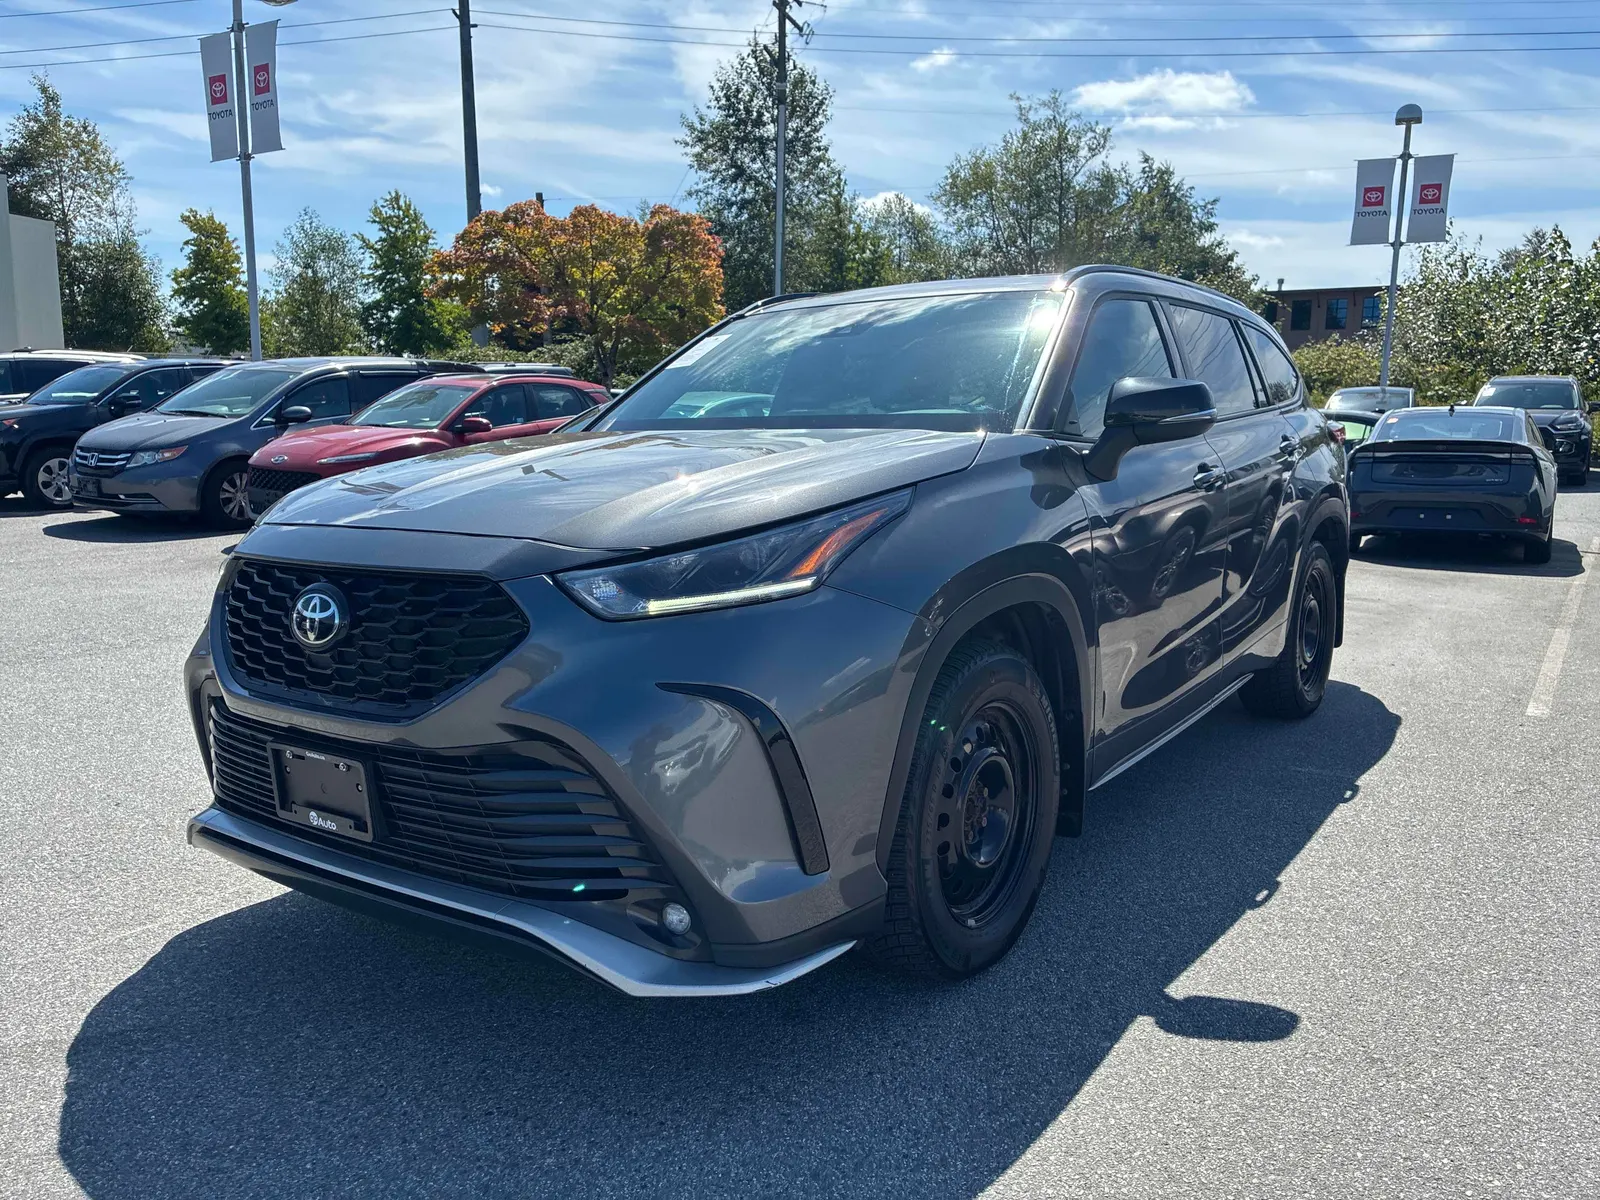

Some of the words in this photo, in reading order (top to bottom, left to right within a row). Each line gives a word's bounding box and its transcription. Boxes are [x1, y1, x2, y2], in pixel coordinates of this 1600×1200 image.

[251, 99, 275, 111] TOYOTA
[208, 109, 233, 121] TOYOTA
[1356, 210, 1388, 218] TOYOTA
[1413, 207, 1445, 215] TOYOTA
